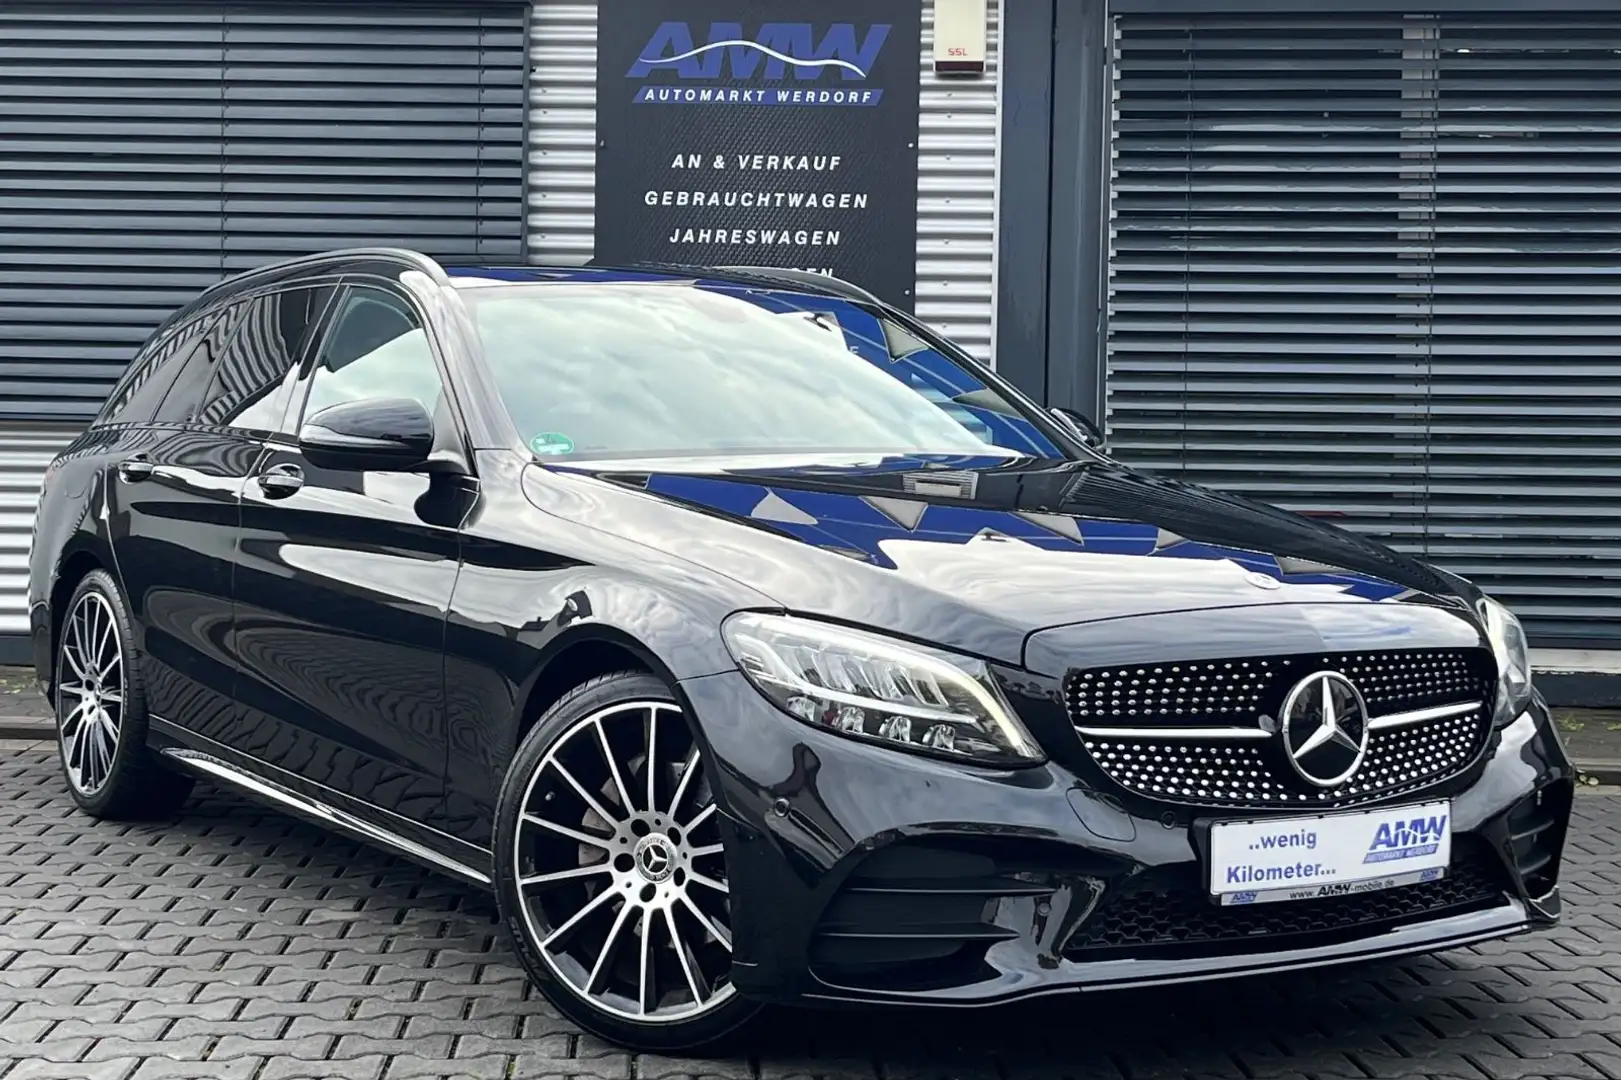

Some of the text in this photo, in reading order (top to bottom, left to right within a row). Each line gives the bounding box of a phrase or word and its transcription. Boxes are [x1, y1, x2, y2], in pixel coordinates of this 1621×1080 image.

[625, 21, 893, 80] AMW
[645, 88, 872, 103] AUTOMARKT WERDORF
[672, 154, 842, 171] AN & VERKAUF
[644, 190, 868, 209] GEBRAUCHTWAGEN
[669, 229, 841, 246] JAHRESWAGEN
[1369, 815, 1447, 850] AMW
